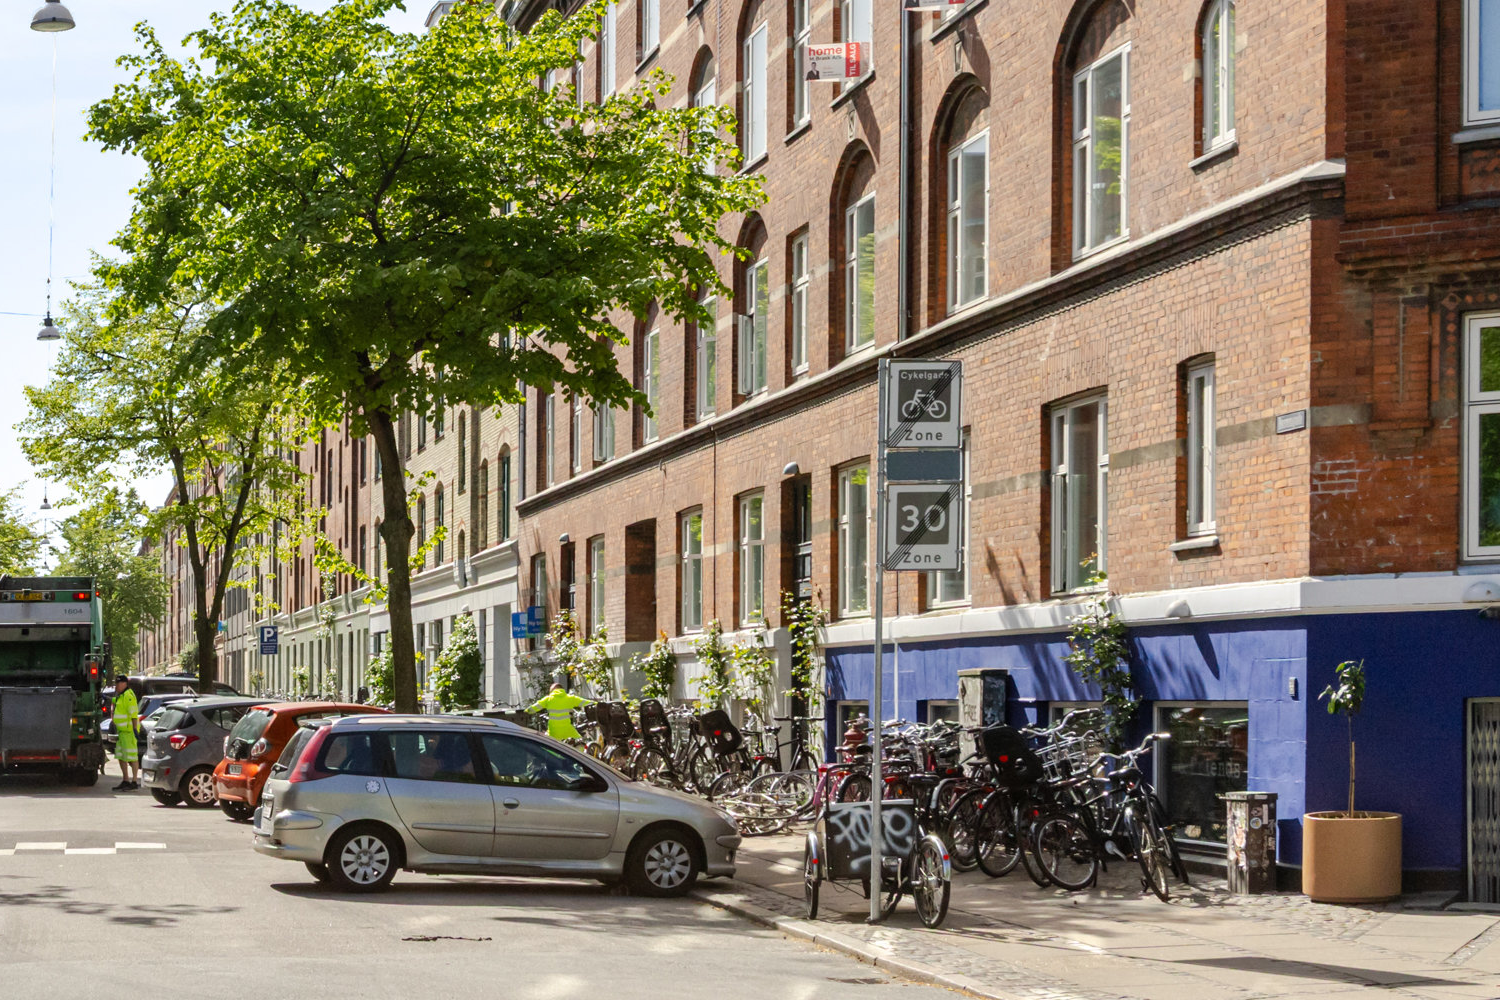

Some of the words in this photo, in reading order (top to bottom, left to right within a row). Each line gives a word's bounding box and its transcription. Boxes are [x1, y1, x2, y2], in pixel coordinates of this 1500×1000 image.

[808, 47, 842, 56] home
[905, 429, 943, 441] Zone
[900, 505, 946, 532] 30
[903, 552, 941, 563] Zone
[263, 628, 274, 642] P
